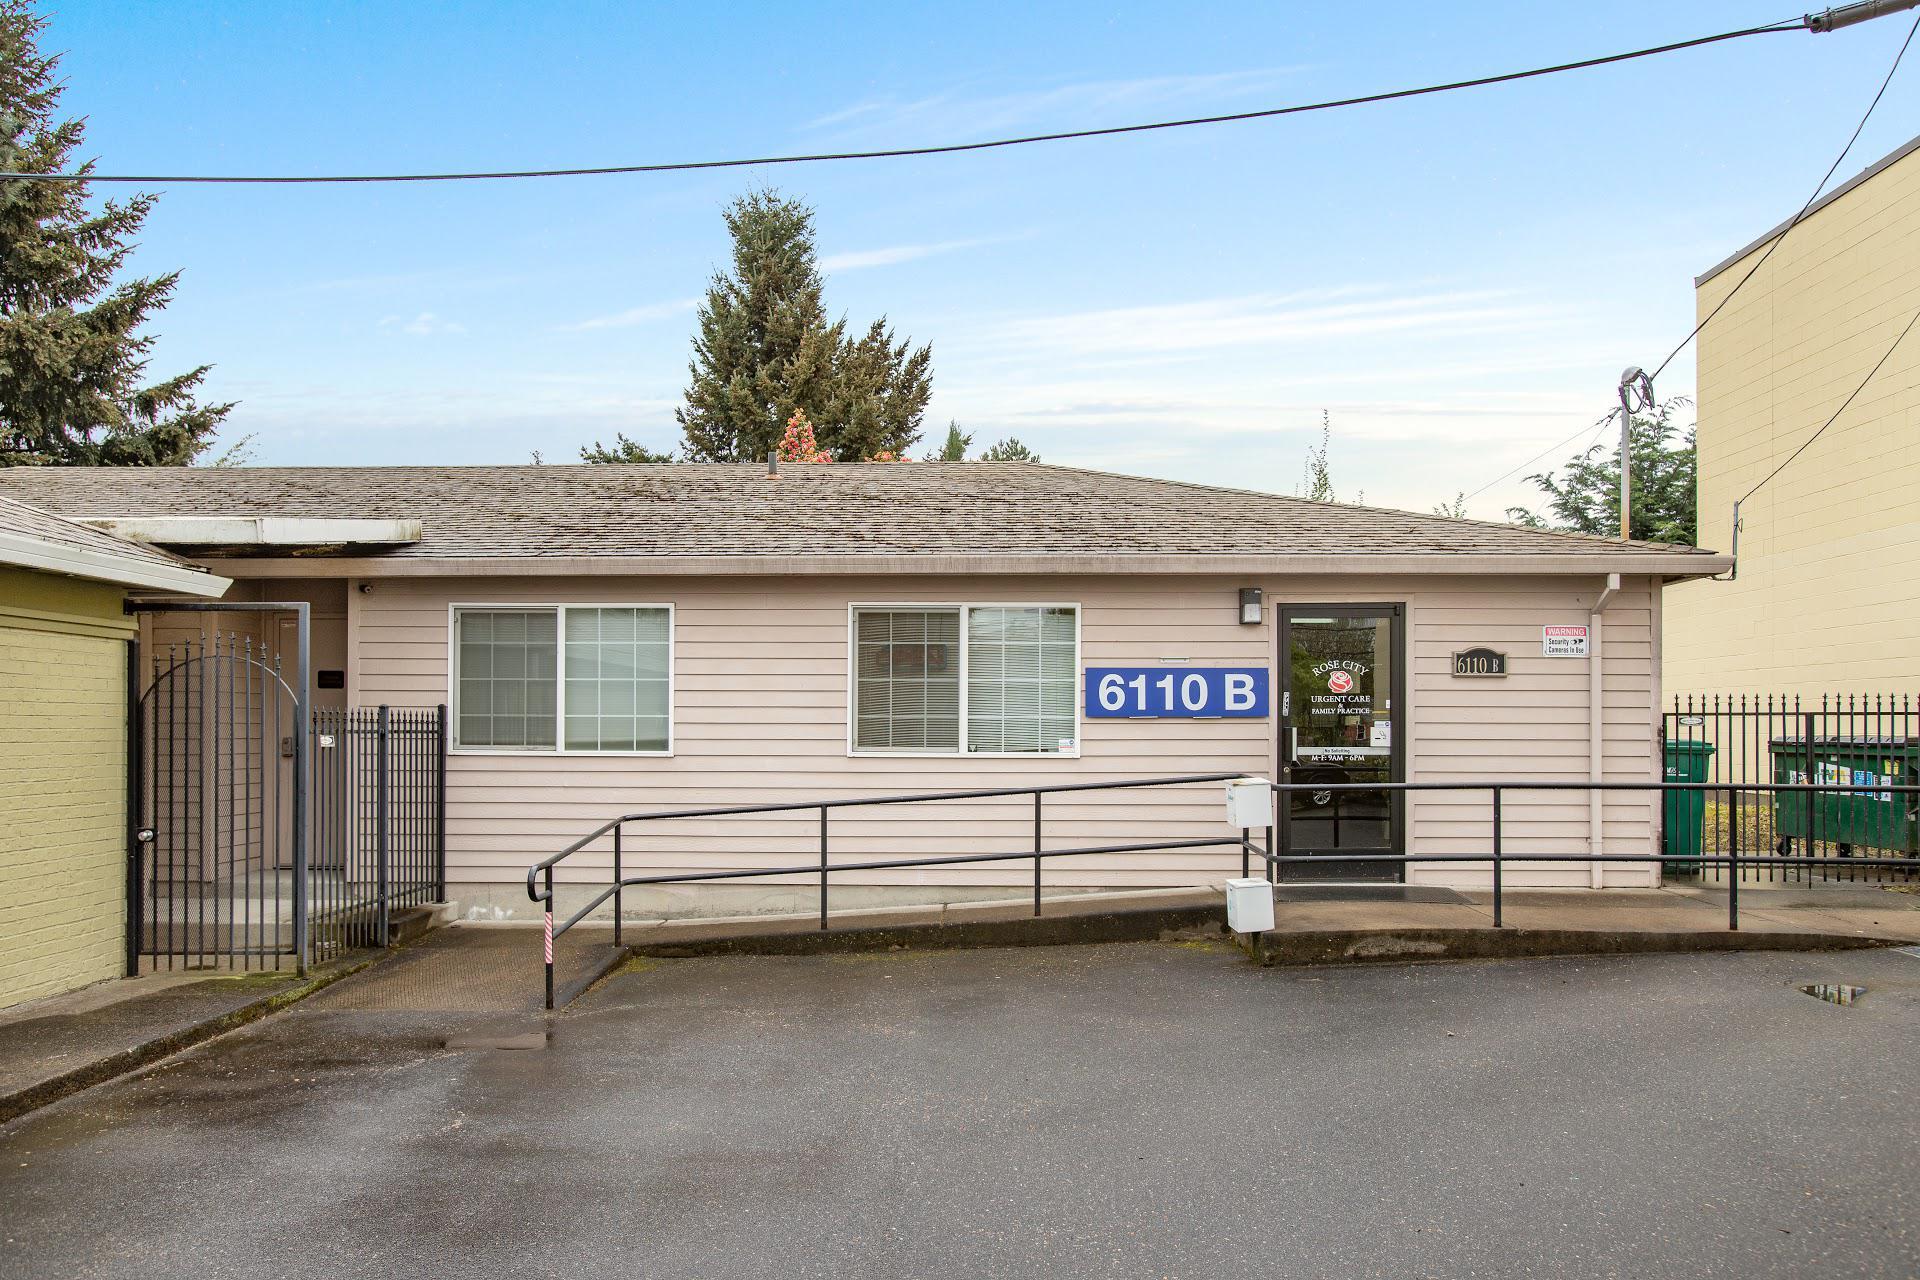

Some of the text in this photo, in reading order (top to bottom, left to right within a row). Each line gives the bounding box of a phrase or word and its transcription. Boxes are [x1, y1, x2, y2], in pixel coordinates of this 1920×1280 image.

[1548, 628, 1585, 636] WARNING
[1549, 638, 1569, 646] Security
[1312, 660, 1370, 676] ROSE CITY
[1457, 657, 1499, 673] 6110 B
[1098, 673, 1256, 711] 6110 B
[1311, 695, 1370, 703] URGENT CARE
